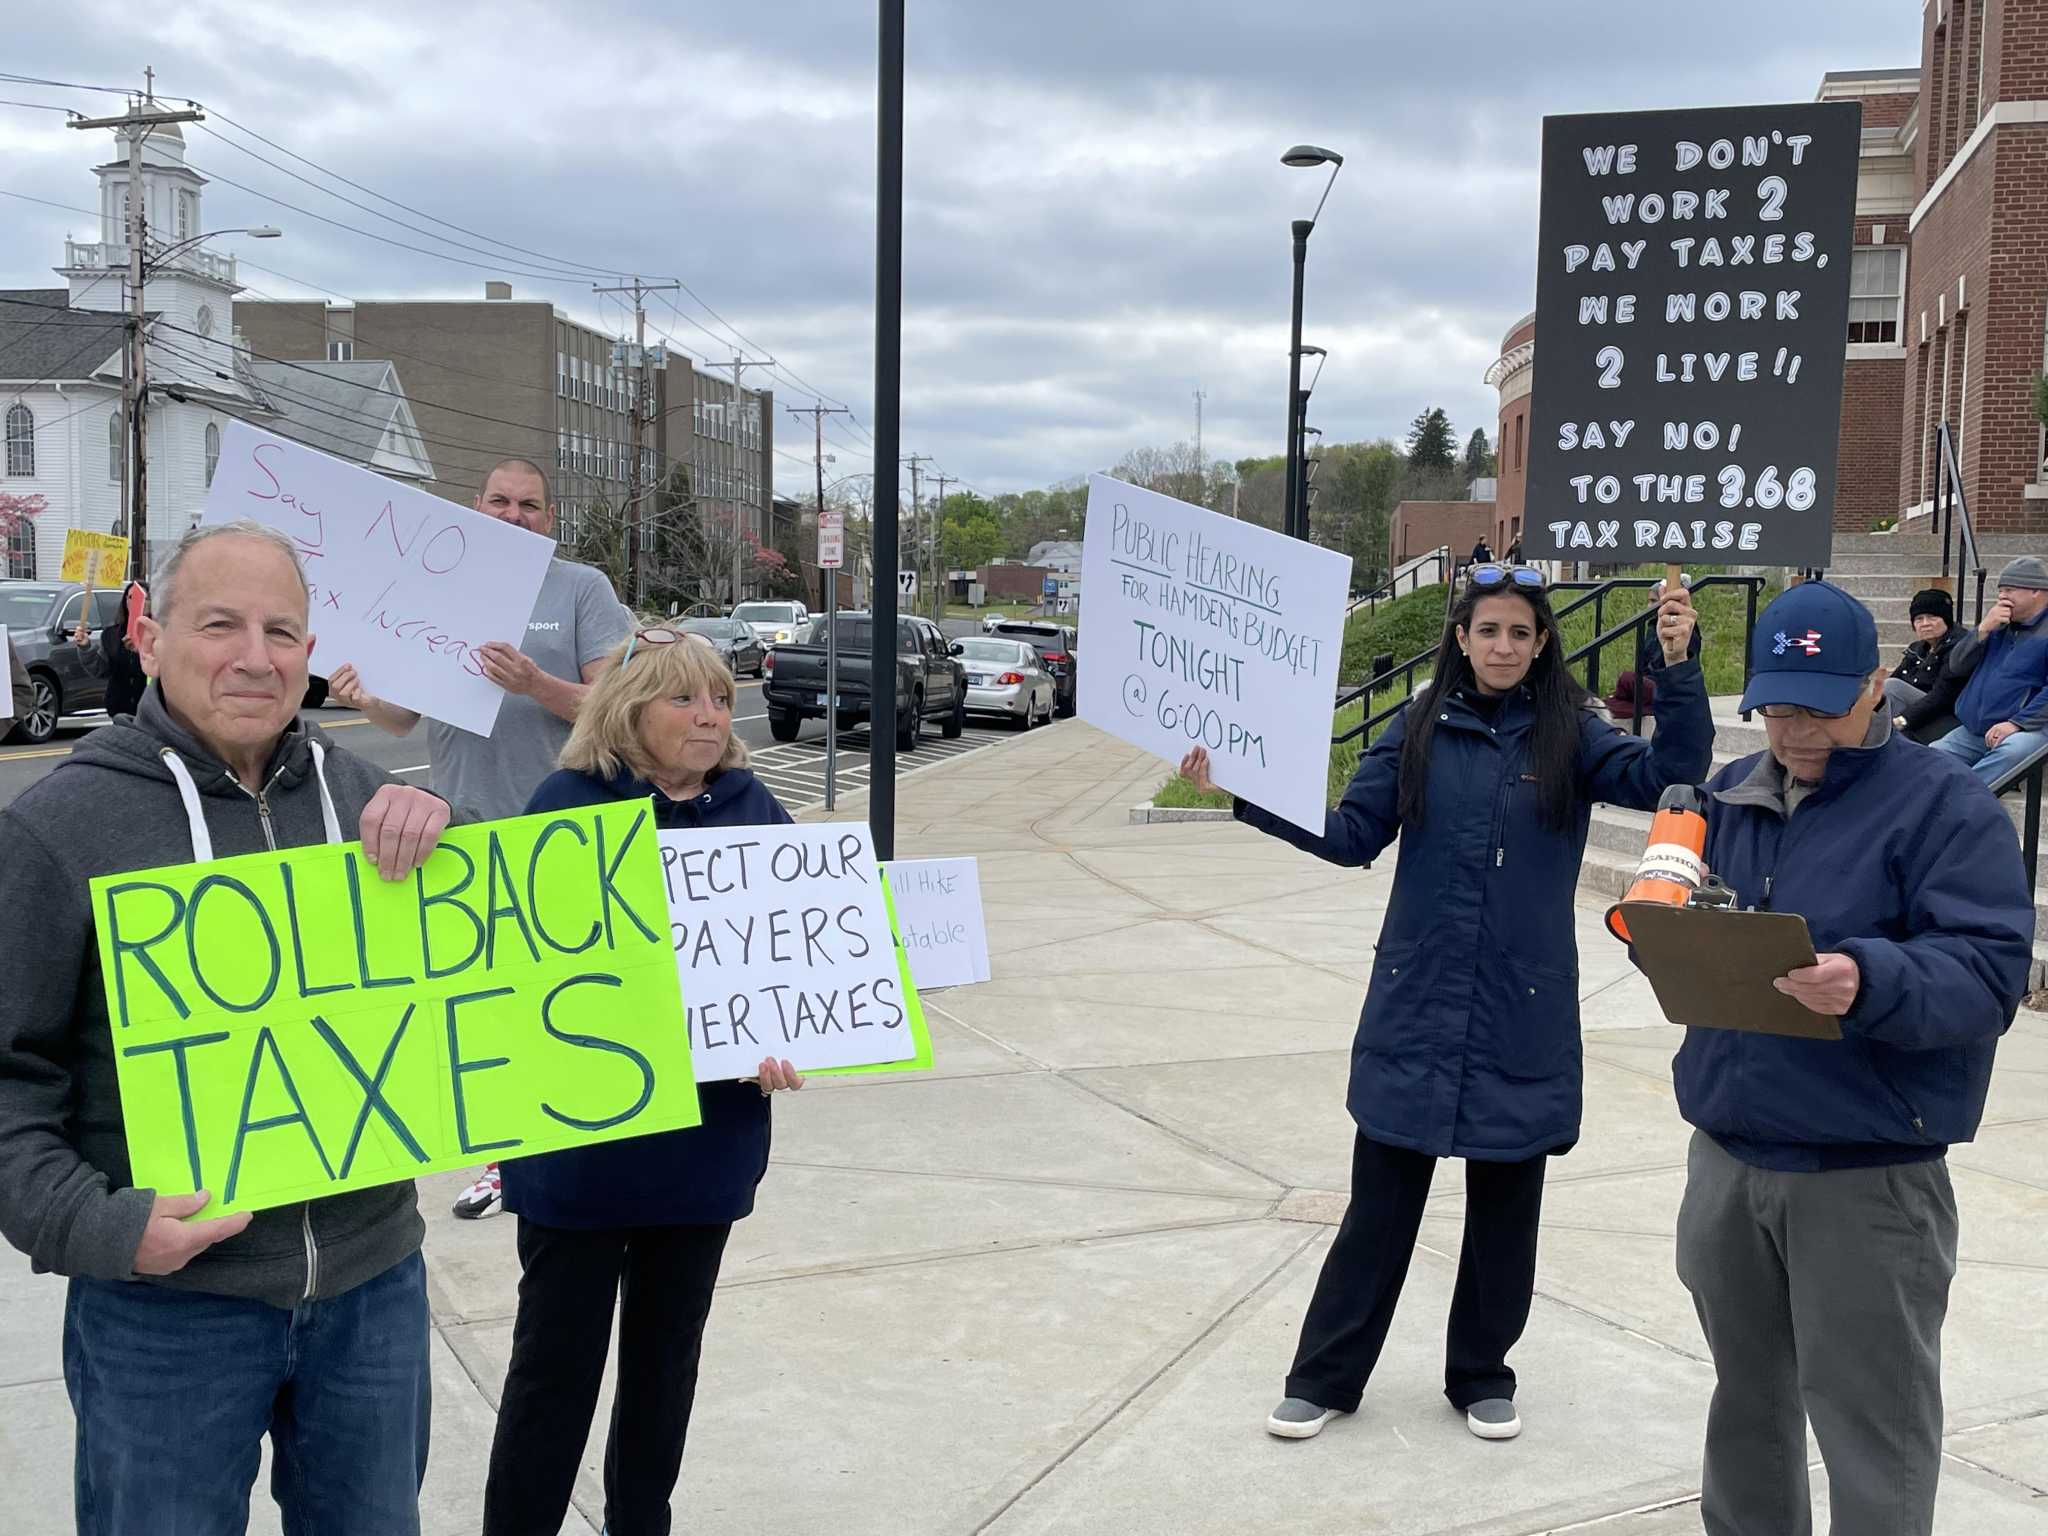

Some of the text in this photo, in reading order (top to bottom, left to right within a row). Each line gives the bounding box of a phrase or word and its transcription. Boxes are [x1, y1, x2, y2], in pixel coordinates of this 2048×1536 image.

[1583, 130, 1812, 176] WE DON'T
[1602, 175, 1788, 225] WORK 2
[1564, 232, 1828, 273] PAY TAXES,
[1578, 290, 1801, 325] WE WORK
[1596, 345, 1624, 389] 2
[1558, 419, 1742, 452] SAY NO!
[247, 443, 466, 574] Say NO
[1569, 464, 1817, 511] TO THE 3.68
[1112, 503, 1281, 608] PUBLIC HEARING
[1549, 520, 1763, 551] TAX RAISE
[527, 622, 560, 632] sport
[1121, 574, 1151, 606] FOR
[1244, 612, 1324, 677] BUDGET
[1133, 619, 1245, 702] TONIGHT
[1122, 673, 1147, 718] @
[771, 834, 868, 884] OUR
[687, 978, 904, 1050] ER TAXES
[124, 973, 656, 1204] TAXES
